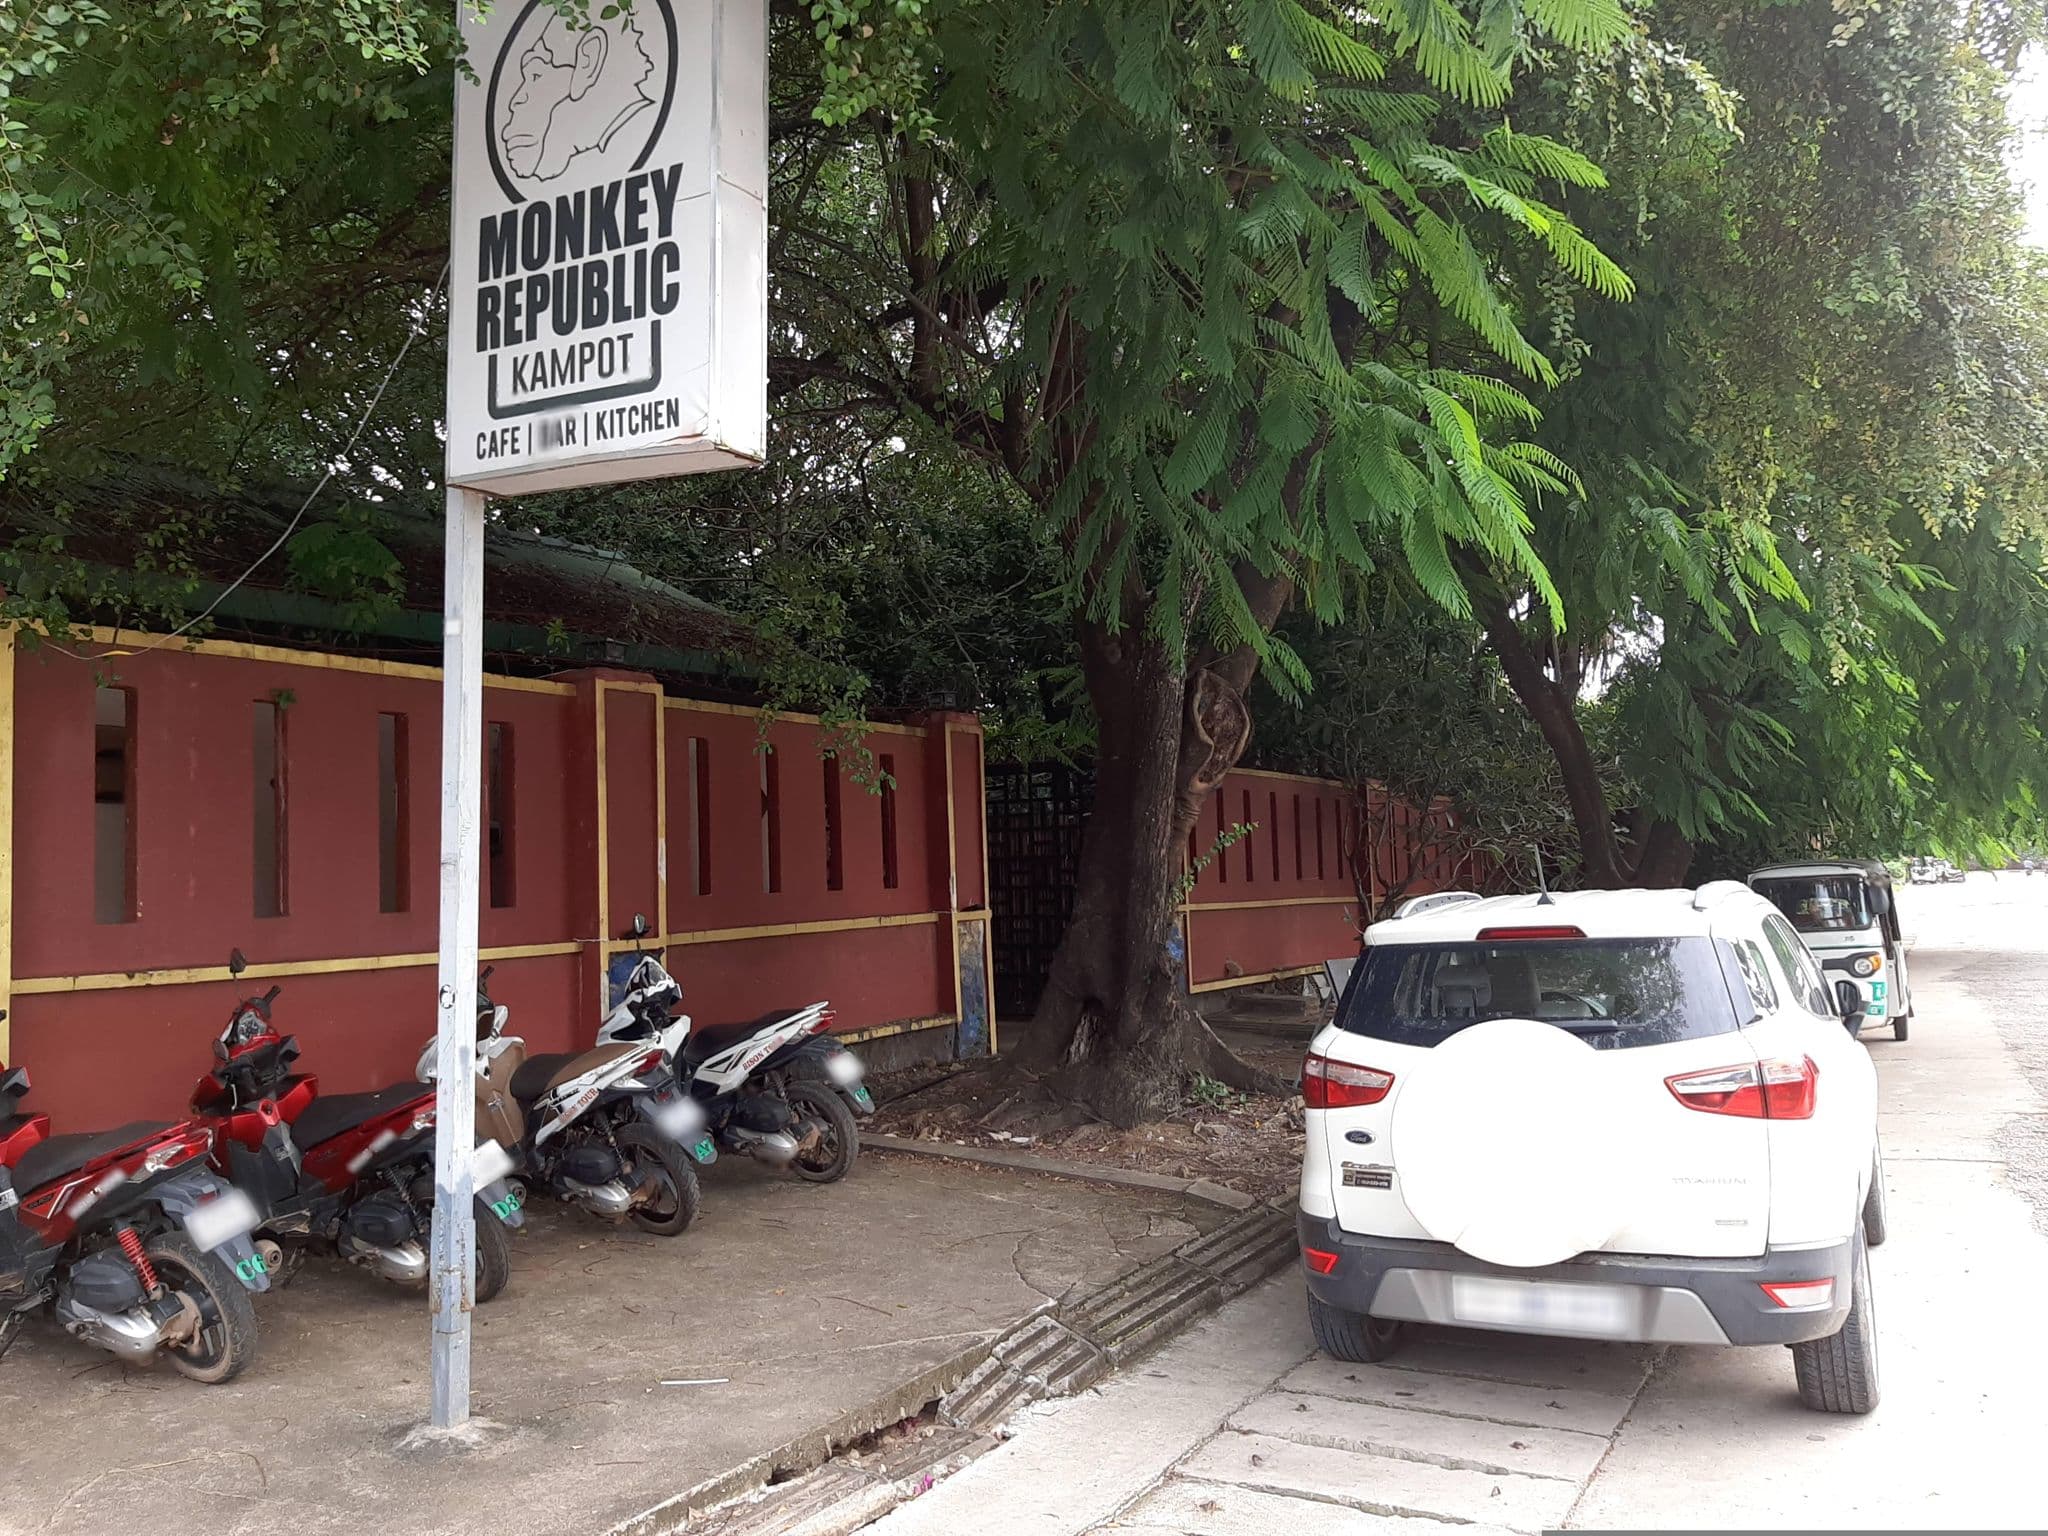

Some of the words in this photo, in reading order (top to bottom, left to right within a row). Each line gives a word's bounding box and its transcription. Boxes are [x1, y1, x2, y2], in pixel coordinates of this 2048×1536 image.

[478, 162, 684, 283] MONKEY
[476, 241, 680, 353] REPUBLIC
[511, 333, 634, 396] KAMPOT
[476, 426, 521, 460] CAFE
[538, 415, 577, 449] AR
[596, 397, 680, 441] KITCHEN
[742, 1050, 765, 1071] BISON
[577, 1087, 599, 1108] TOUR
[491, 1193, 520, 1220] D3
[236, 1253, 267, 1281] C6
